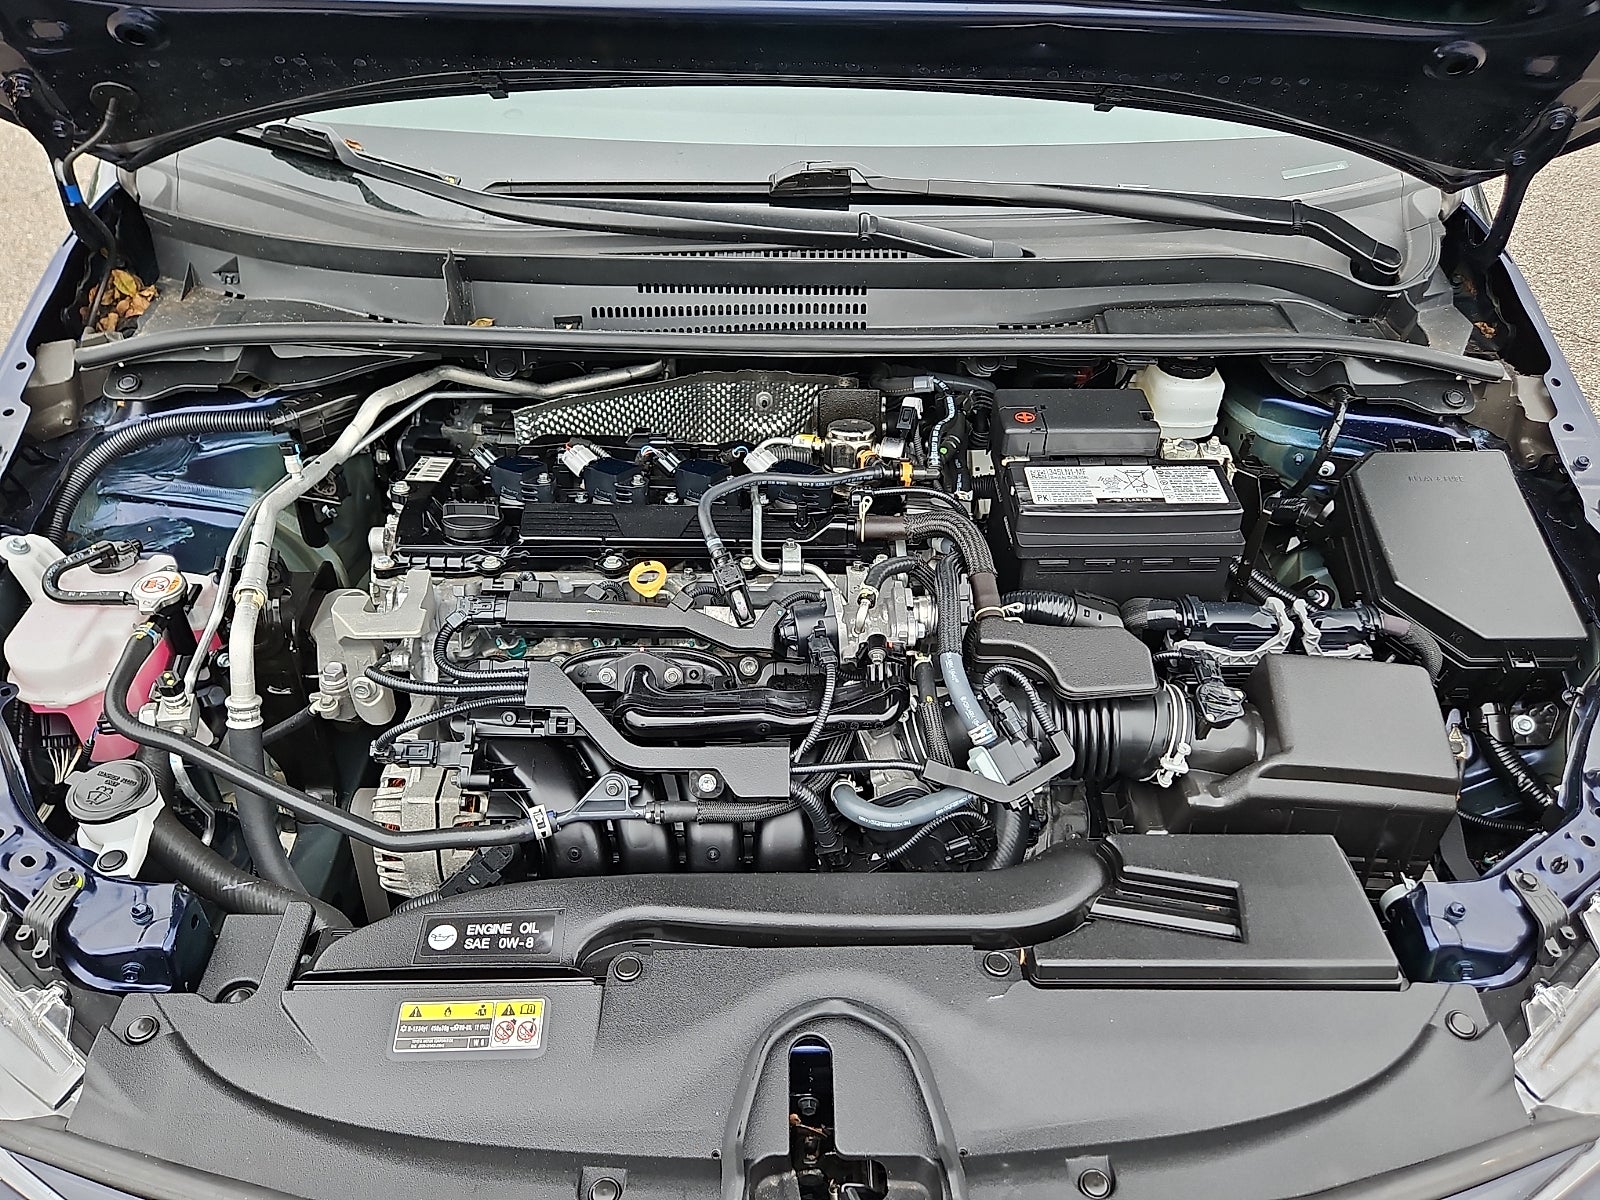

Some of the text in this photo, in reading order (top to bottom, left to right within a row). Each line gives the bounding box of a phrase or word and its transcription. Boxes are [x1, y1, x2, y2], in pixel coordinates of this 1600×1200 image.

[466, 921, 540, 936] ENGINE OIL
[463, 936, 534, 950] SAE 0W-8
